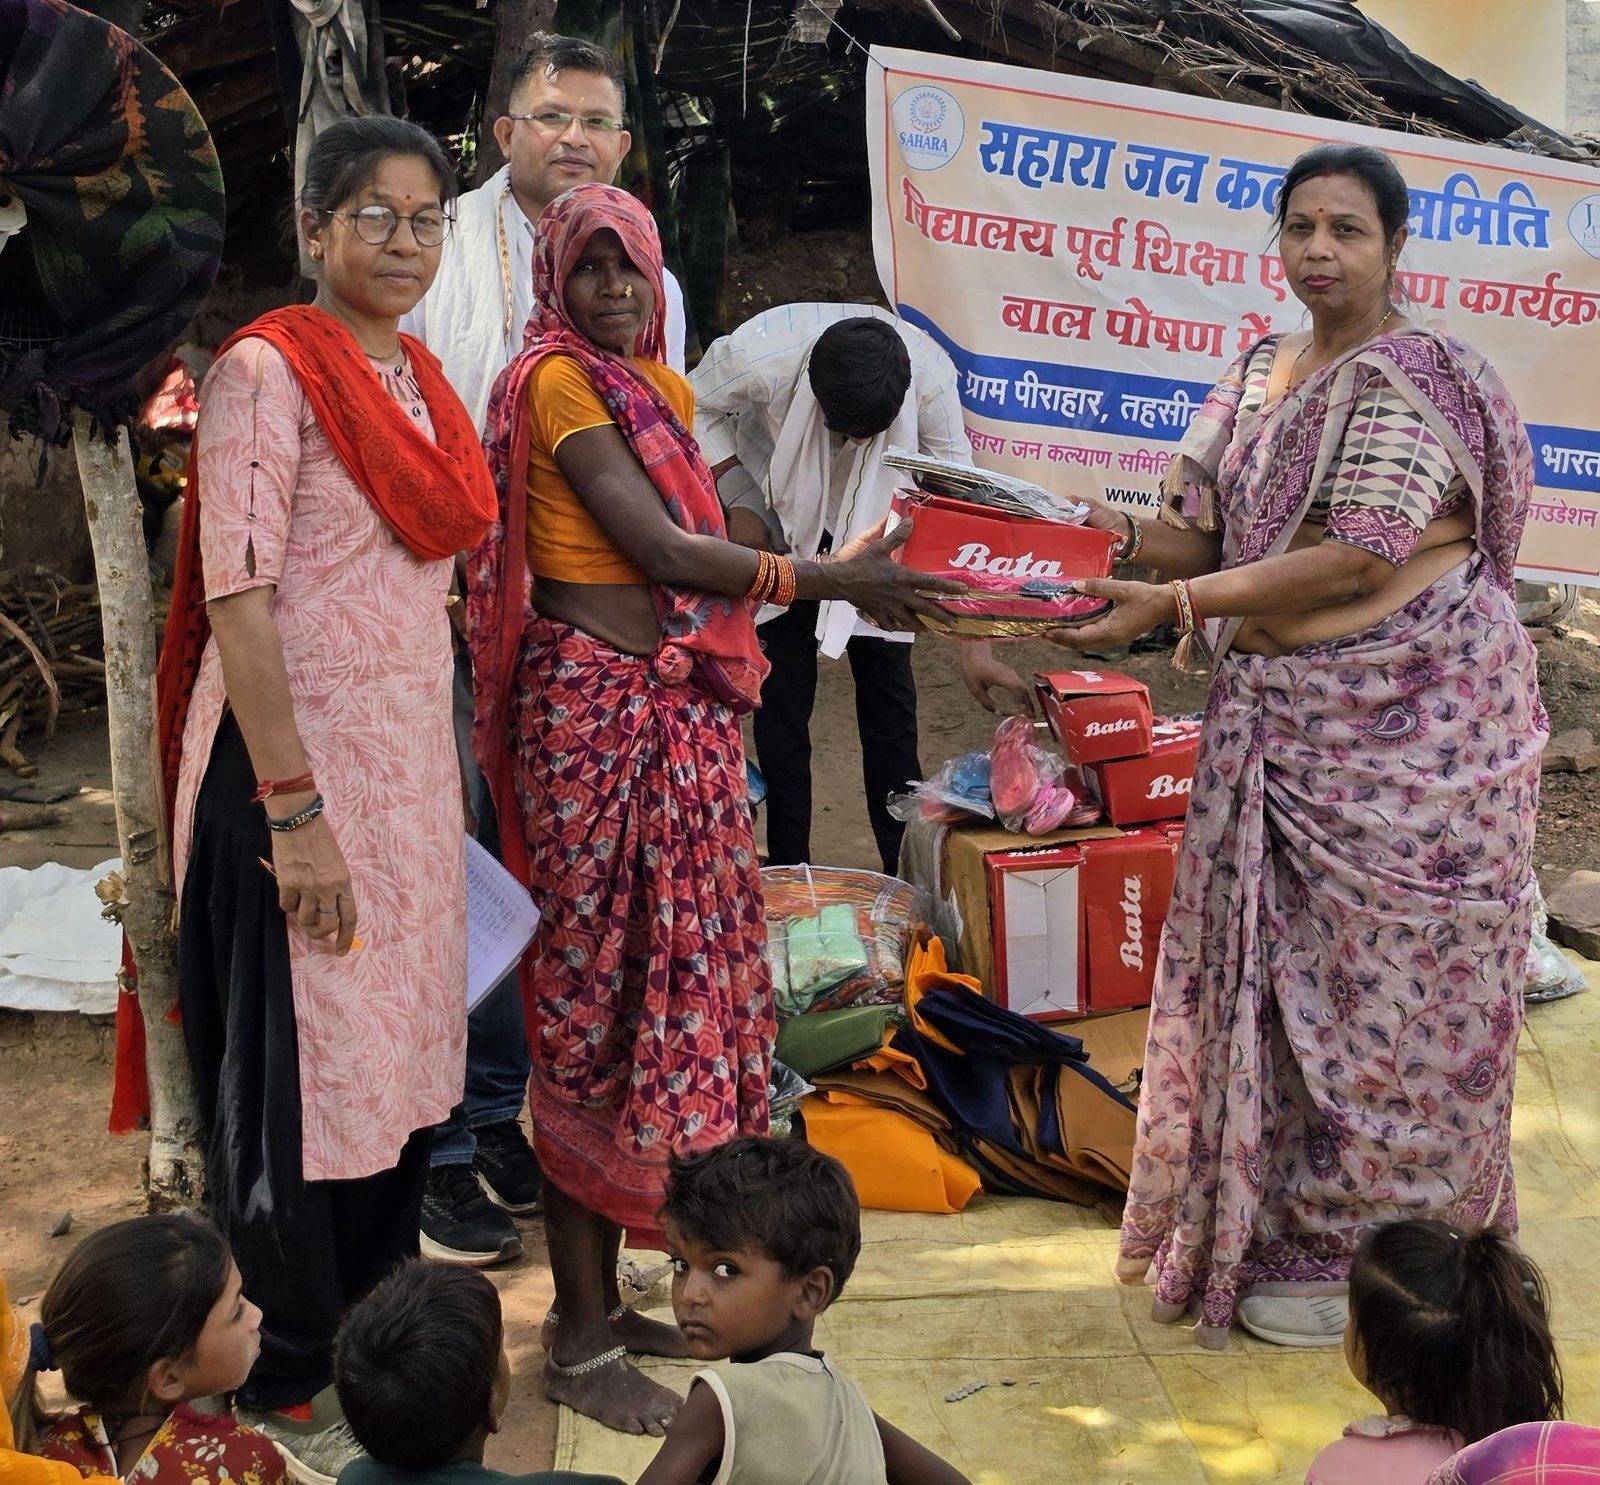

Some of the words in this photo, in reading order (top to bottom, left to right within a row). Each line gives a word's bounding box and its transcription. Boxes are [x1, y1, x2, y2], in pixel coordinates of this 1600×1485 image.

[899, 131, 947, 152] SAHARA
[979, 122, 1117, 189] सहारा
[1125, 144, 1209, 203] जन
[903, 177, 1057, 257] विद्यालय
[1067, 217, 1127, 281] पूर्व
[1132, 220, 1248, 287] शिक्षा
[1459, 272, 1600, 328] कार्यक्र
[1003, 295, 1096, 341] बाल
[1106, 297, 1226, 357] पोषण
[965, 370, 1008, 405] ग्राम
[1012, 440, 1043, 461] जन
[1048, 444, 1113, 470] कल्याण
[949, 543, 1064, 578] Bata
[1083, 718, 1138, 738] Bata
[1145, 774, 1193, 799] Ba
[1120, 874, 1143, 972] Bata
